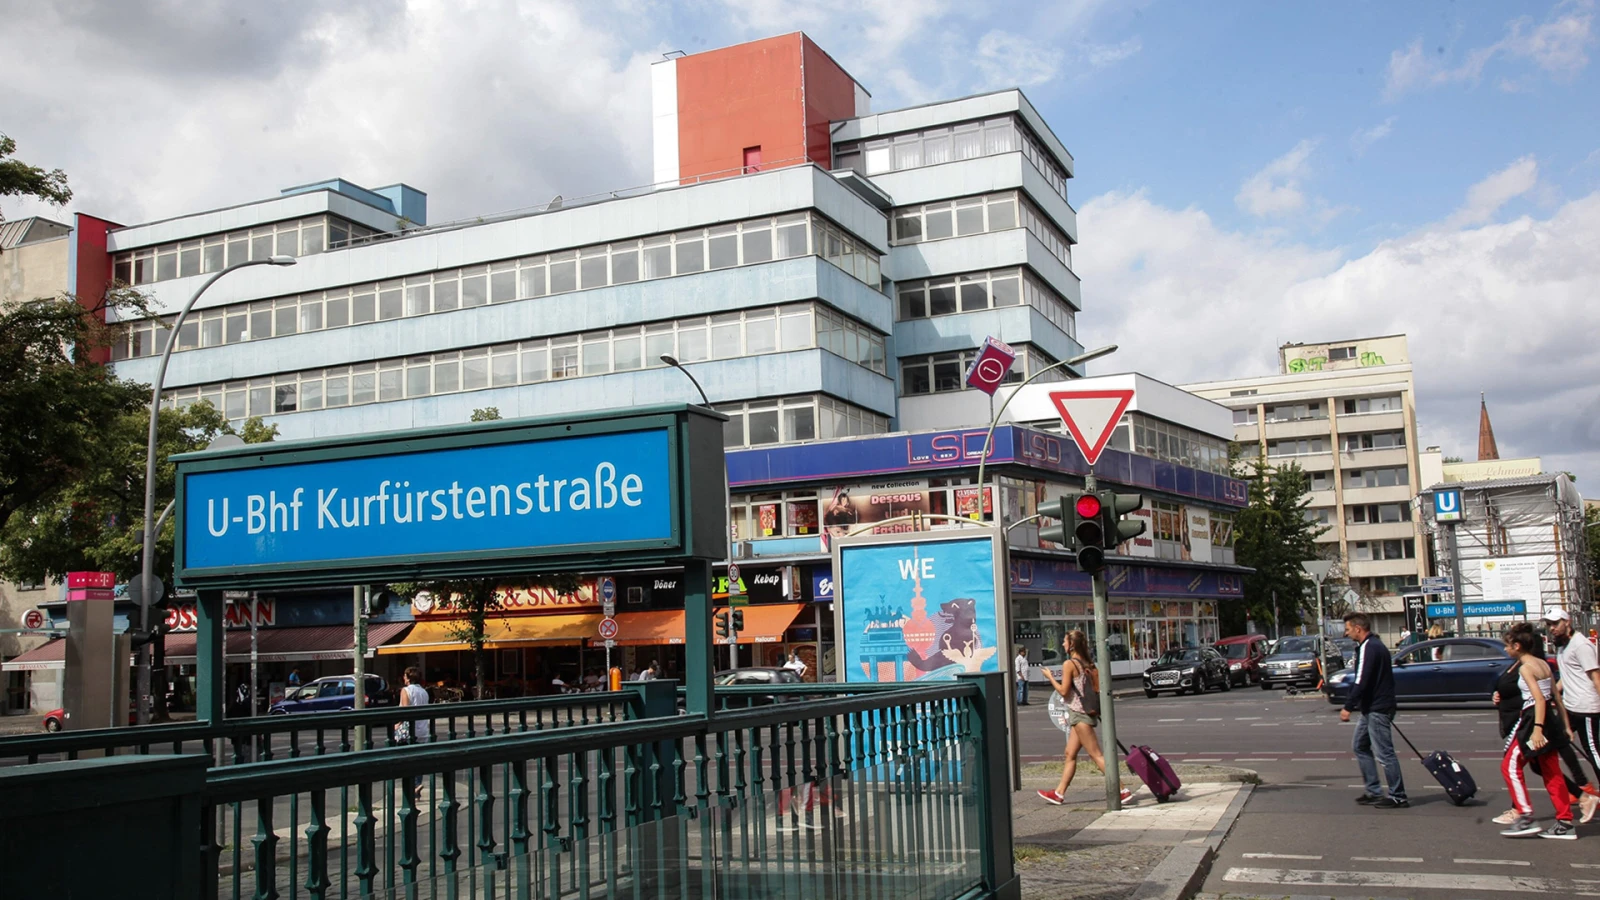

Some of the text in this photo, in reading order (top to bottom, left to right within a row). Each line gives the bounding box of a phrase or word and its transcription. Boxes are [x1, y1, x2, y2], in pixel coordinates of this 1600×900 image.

[907, 431, 995, 465] LSD
[1021, 432, 1061, 464] LSD
[1484, 465, 1535, 476] Lehmann
[207, 461, 643, 538] U-Bhf Kurfürstenstraße
[871, 493, 921, 504] Dessous
[1223, 479, 1246, 502] LSD
[1438, 492, 1456, 512] U
[898, 558, 936, 580] WE
[1010, 559, 1033, 586] SD
[101, 573, 109, 587] T
[654, 580, 676, 589] Döner
[754, 574, 780, 586] Kebap
[1218, 574, 1241, 594] LSD
[503, 586, 524, 607] &
[1435, 604, 1516, 615] U-Bhf rfürstenstraße
